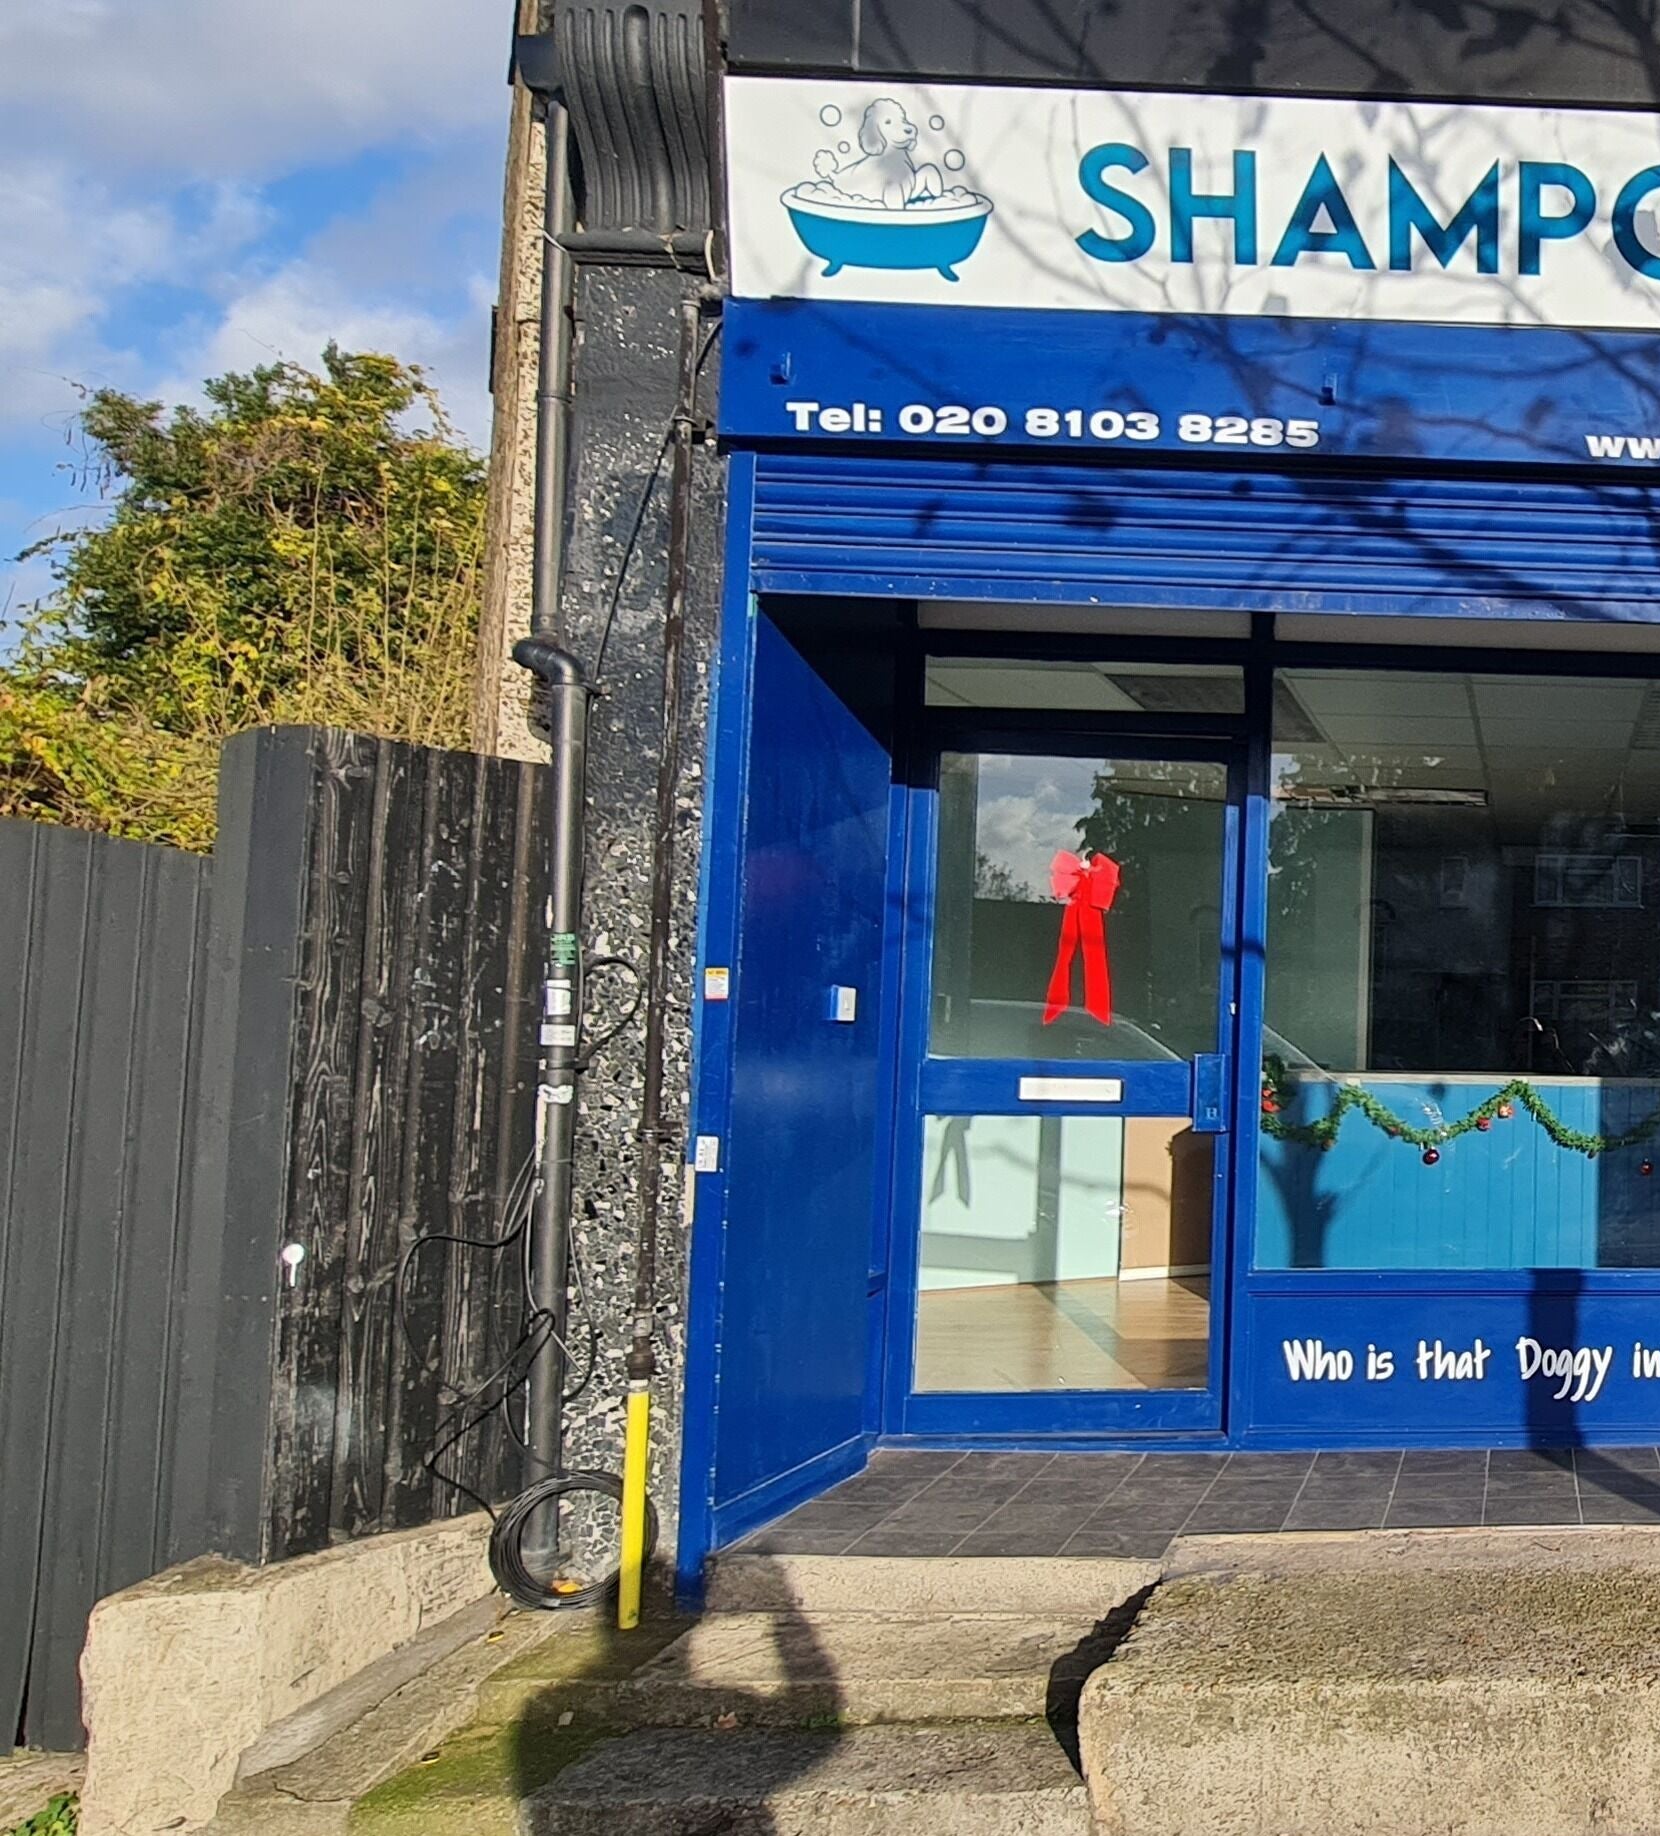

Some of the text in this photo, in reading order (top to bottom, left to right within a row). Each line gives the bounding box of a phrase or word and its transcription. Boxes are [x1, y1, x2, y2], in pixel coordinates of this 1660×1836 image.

[785, 400, 1320, 448] Tel: 020 8103 8285
[1281, 1339, 1354, 1382] Who
[1366, 1344, 1395, 1381] is
[1414, 1339, 1491, 1381] that
[1518, 1335, 1614, 1402] Doggy
